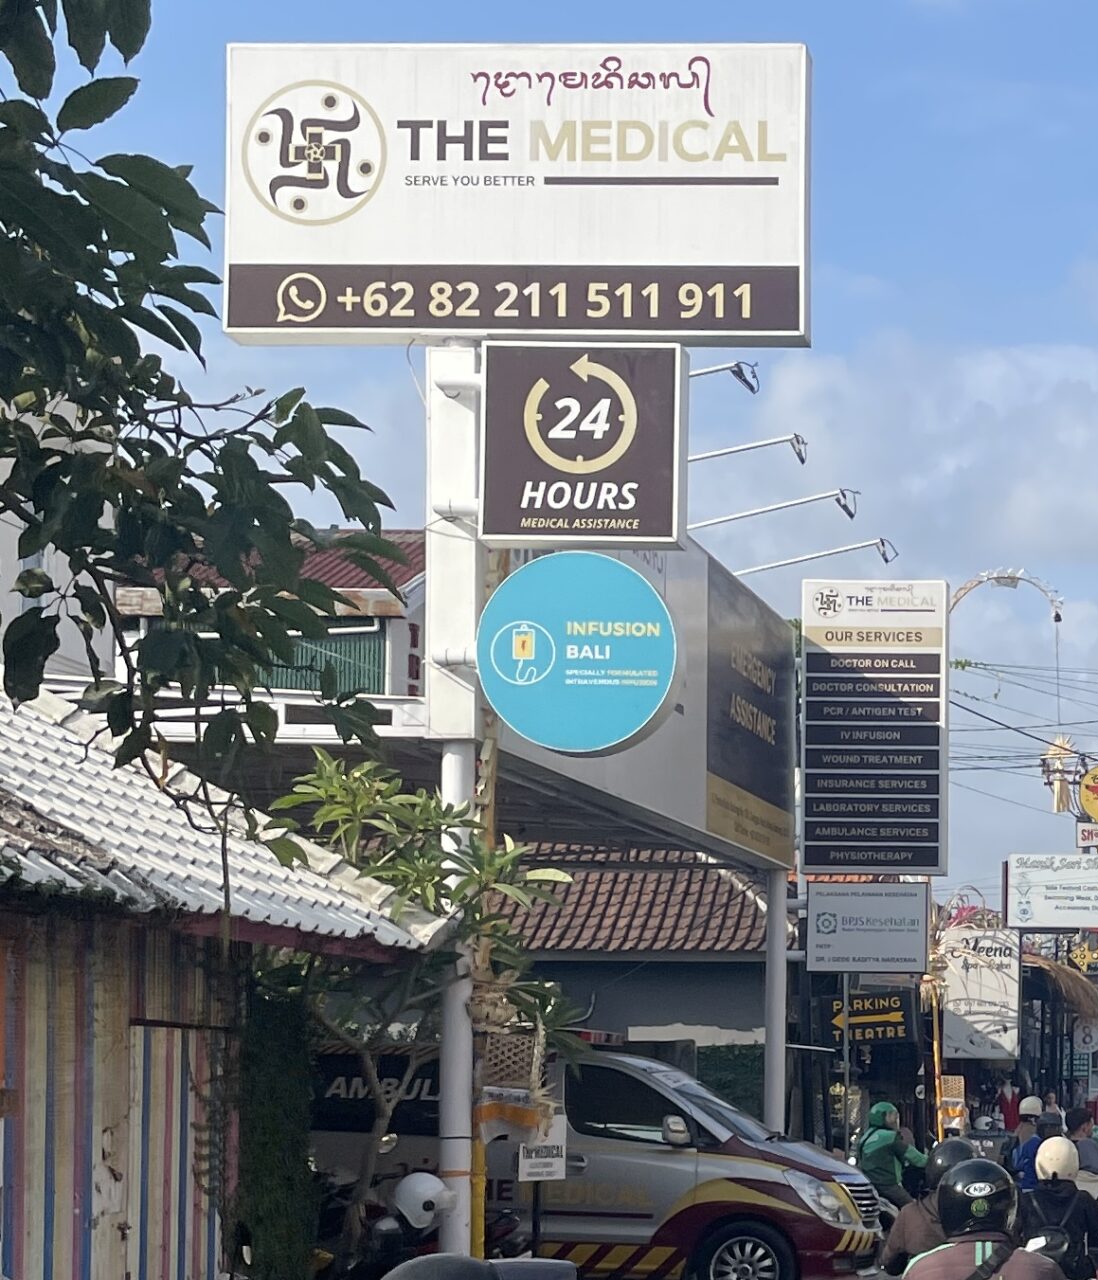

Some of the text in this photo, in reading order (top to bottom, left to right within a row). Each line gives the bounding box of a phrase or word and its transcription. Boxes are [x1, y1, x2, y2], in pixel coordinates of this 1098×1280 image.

[397, 120, 787, 162] THE MEDICAL
[405, 175, 535, 187] SERVE YOU BETTER
[337, 282, 752, 319] +62 82 211 511 911
[547, 397, 612, 440] 24
[520, 481, 639, 510] HOURS
[520, 517, 640, 530] MEDICAL ASSISTANCE
[846, 596, 937, 608] THE MEDICAL
[566, 621, 660, 637] INFUSION
[825, 630, 923, 643] OUR SERVICES
[566, 644, 610, 659] BALI
[830, 659, 916, 669] DOCTOR ON CALL
[812, 683, 934, 693] DOCTOR CONSULTATION
[823, 707, 844, 716] PCR
[852, 707, 895, 716] ANTIGEN
[897, 707, 923, 717] TEST
[729, 693, 776, 746] ASSISTANCE
[841, 731, 901, 740] IV INFUSION
[822, 755, 923, 765] WOUND TREATMENT
[817, 779, 927, 789] INSURANCE SERVICES
[813, 803, 931, 813] LABORATORY SERVICES
[815, 827, 929, 837] AMBULANCE SERVICES
[829, 851, 914, 861] PHYSIOTHERAPY
[842, 916, 920, 927] BPJS Kesehatan
[324, 1076, 440, 1101] AMBUL
